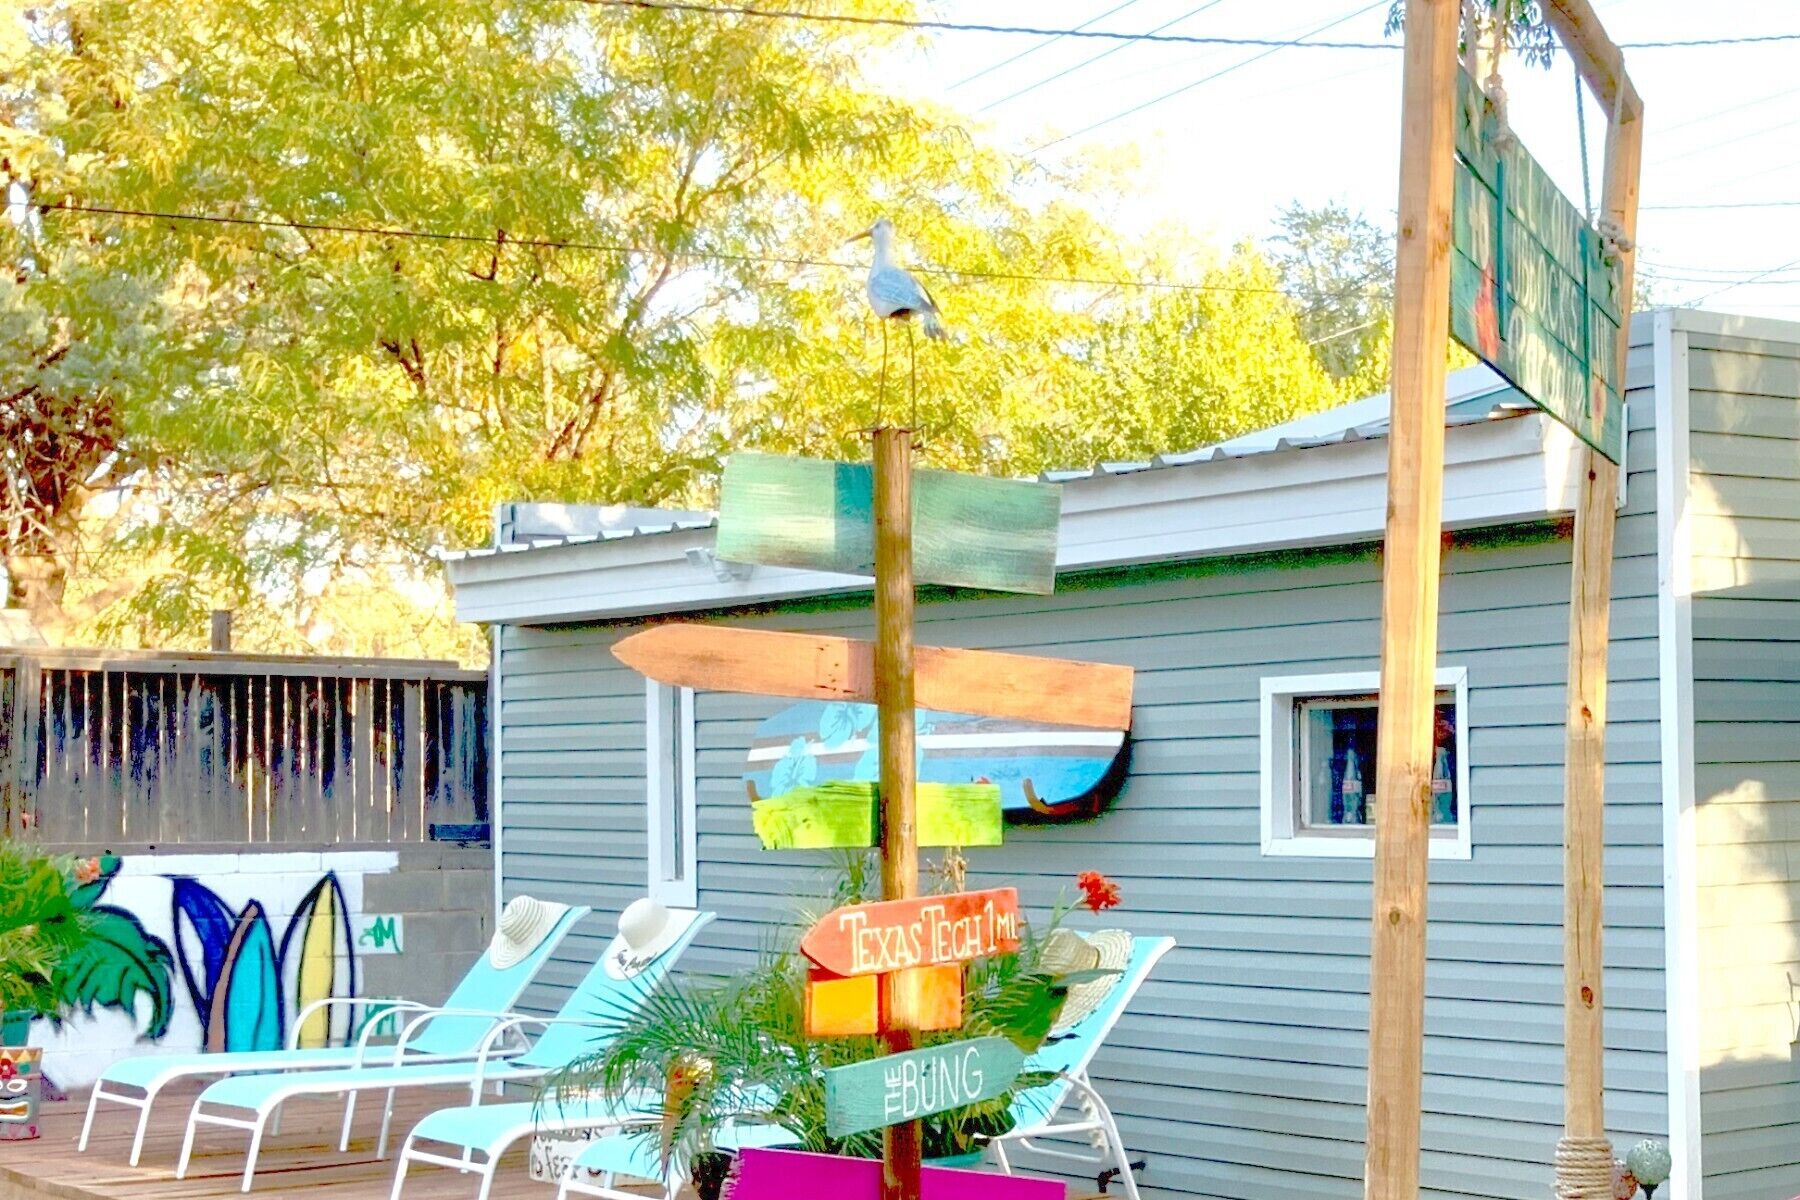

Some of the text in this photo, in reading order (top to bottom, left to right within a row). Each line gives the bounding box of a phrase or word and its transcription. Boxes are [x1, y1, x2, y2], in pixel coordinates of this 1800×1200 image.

[1506, 222, 1578, 351] UBBOCK'S
[839, 911, 922, 973] TEXAS
[920, 905, 983, 963] TECH
[984, 899, 998, 953] 1
[883, 1064, 902, 1121] THE
[902, 1046, 983, 1118] BUNG
